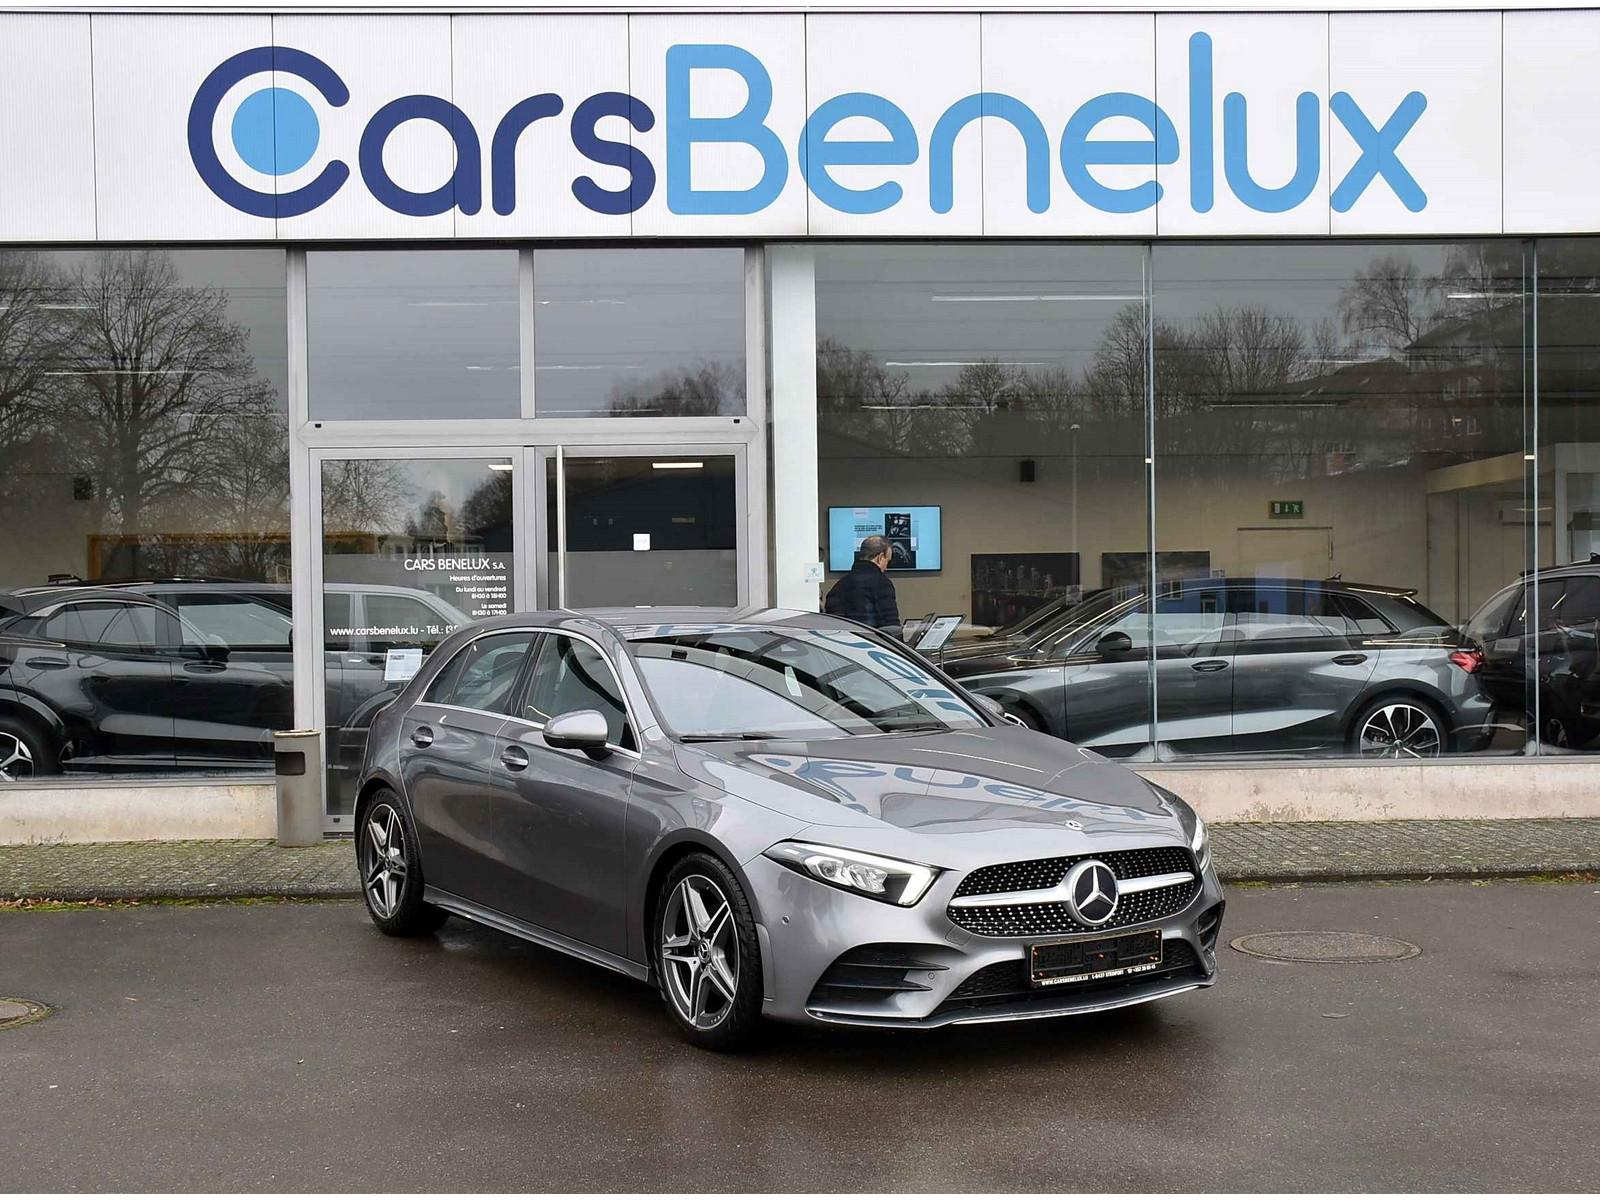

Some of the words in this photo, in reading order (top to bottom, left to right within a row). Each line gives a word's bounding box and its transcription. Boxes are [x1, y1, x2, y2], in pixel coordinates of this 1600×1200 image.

[404, 558, 436, 571] CARS
[437, 558, 491, 570] BENELUX
[492, 562, 506, 570] S.A.
[471, 574, 507, 582] d'ouvertures
[330, 625, 418, 636] www.carsbenelux.lu
